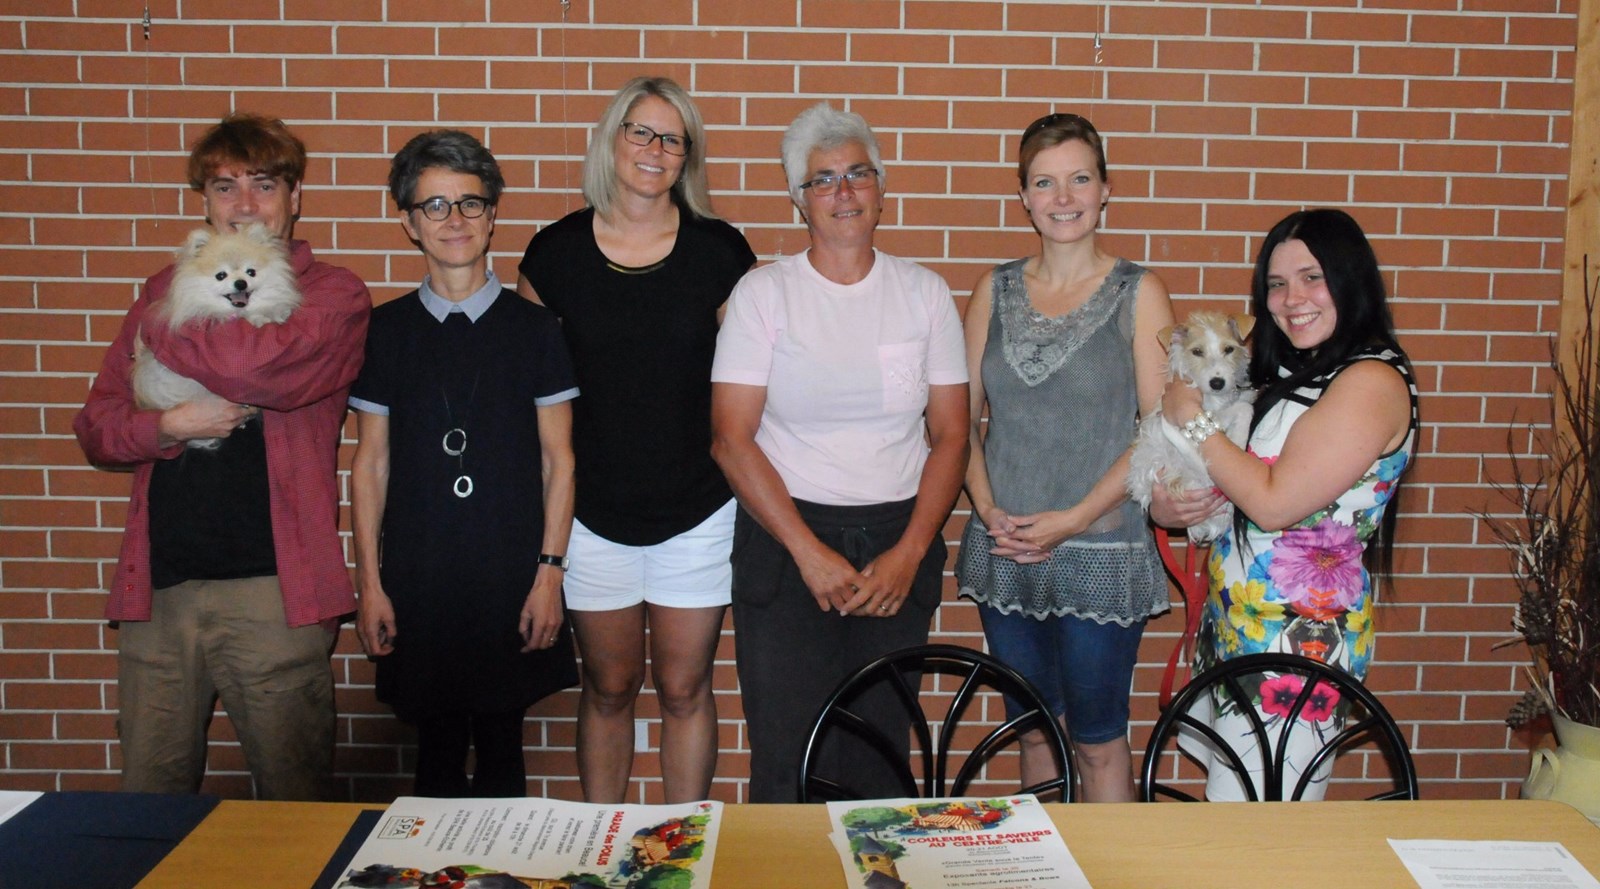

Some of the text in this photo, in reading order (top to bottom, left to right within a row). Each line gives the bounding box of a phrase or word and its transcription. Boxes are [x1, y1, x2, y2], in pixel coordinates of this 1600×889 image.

[395, 818, 415, 836] SPA
[596, 811, 624, 865] PARADE des POILUS
[908, 835, 974, 844] COULEURS
[996, 830, 1051, 839] SAVEURS
[953, 837, 1040, 847] CENTRE-VILLE
